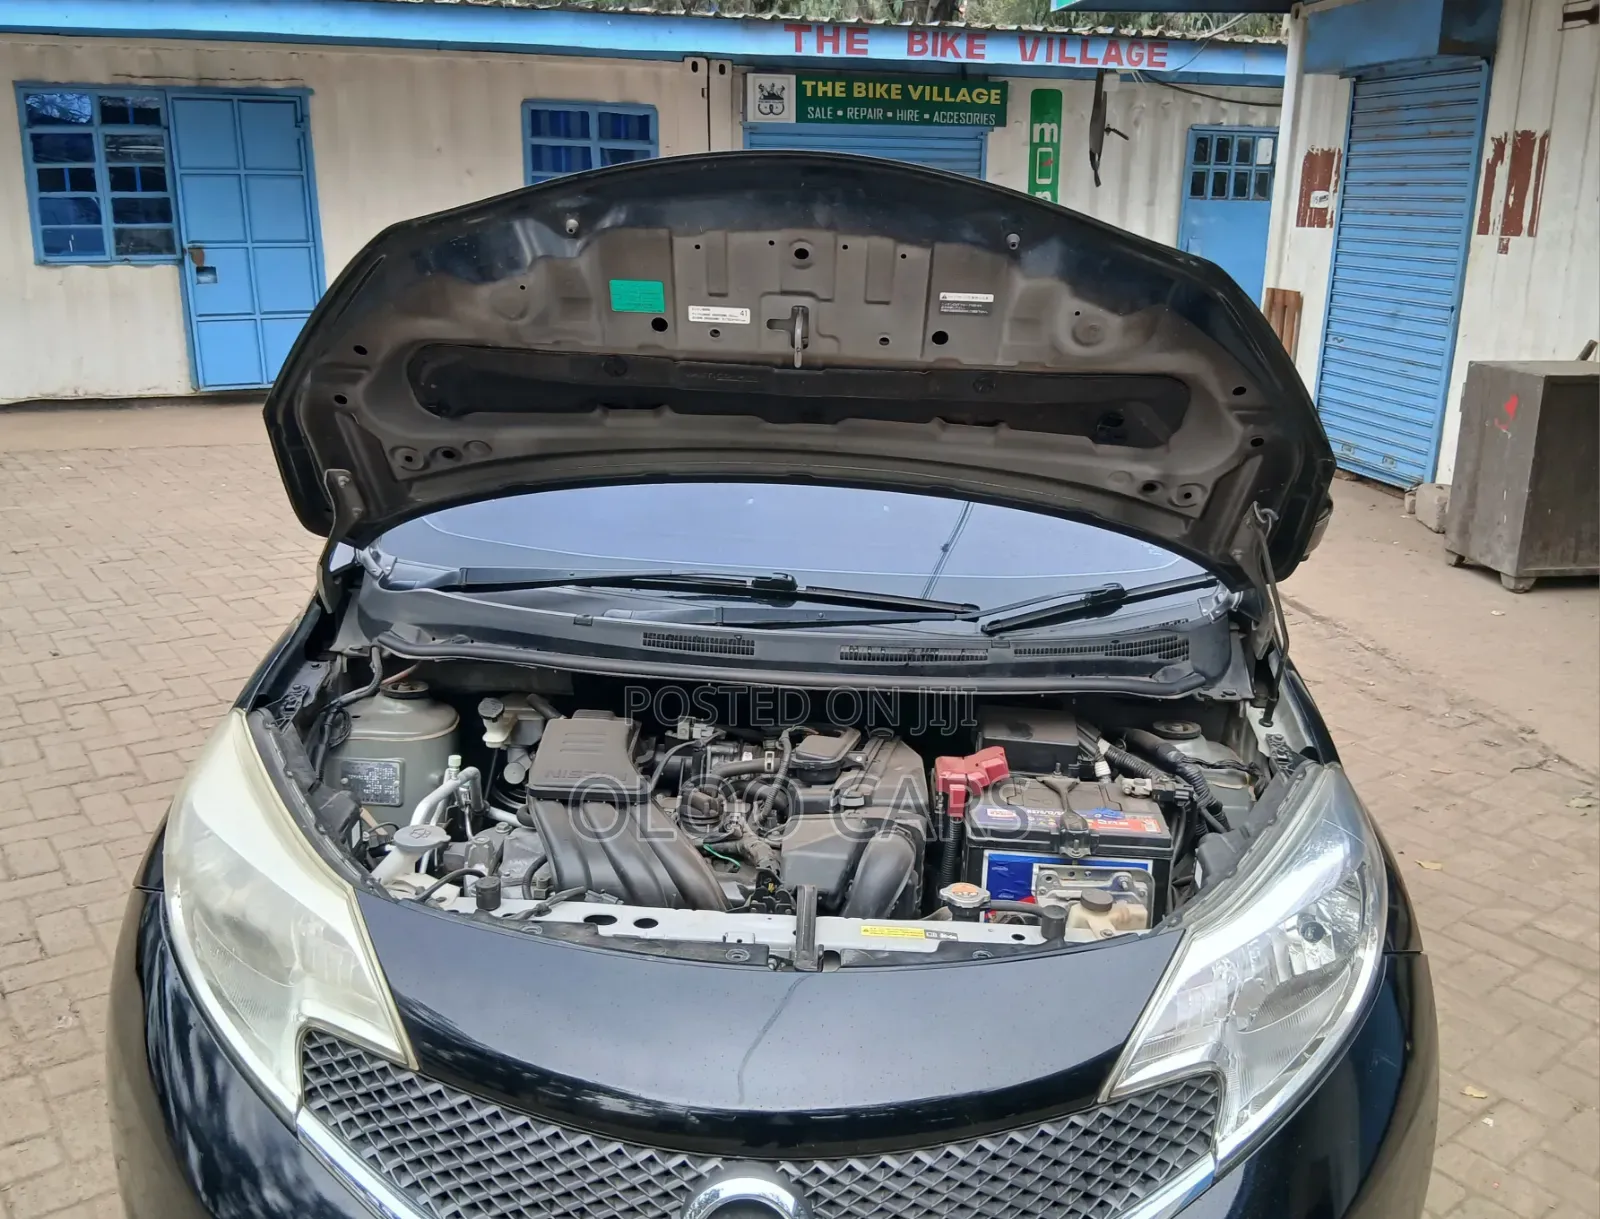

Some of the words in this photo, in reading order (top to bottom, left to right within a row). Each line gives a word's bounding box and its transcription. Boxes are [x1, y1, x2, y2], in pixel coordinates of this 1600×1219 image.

[784, 23, 869, 56] THE
[906, 30, 987, 60] BIKE
[1017, 35, 1169, 68] VILLAGE
[802, 80, 846, 98] THE
[853, 82, 902, 100] BIKE
[908, 84, 1001, 105] VILLAGE
[807, 106, 833, 119] SALE
[846, 107, 884, 121] REPAIR
[896, 108, 920, 122] HIRE
[932, 110, 996, 126] ACCESORIES
